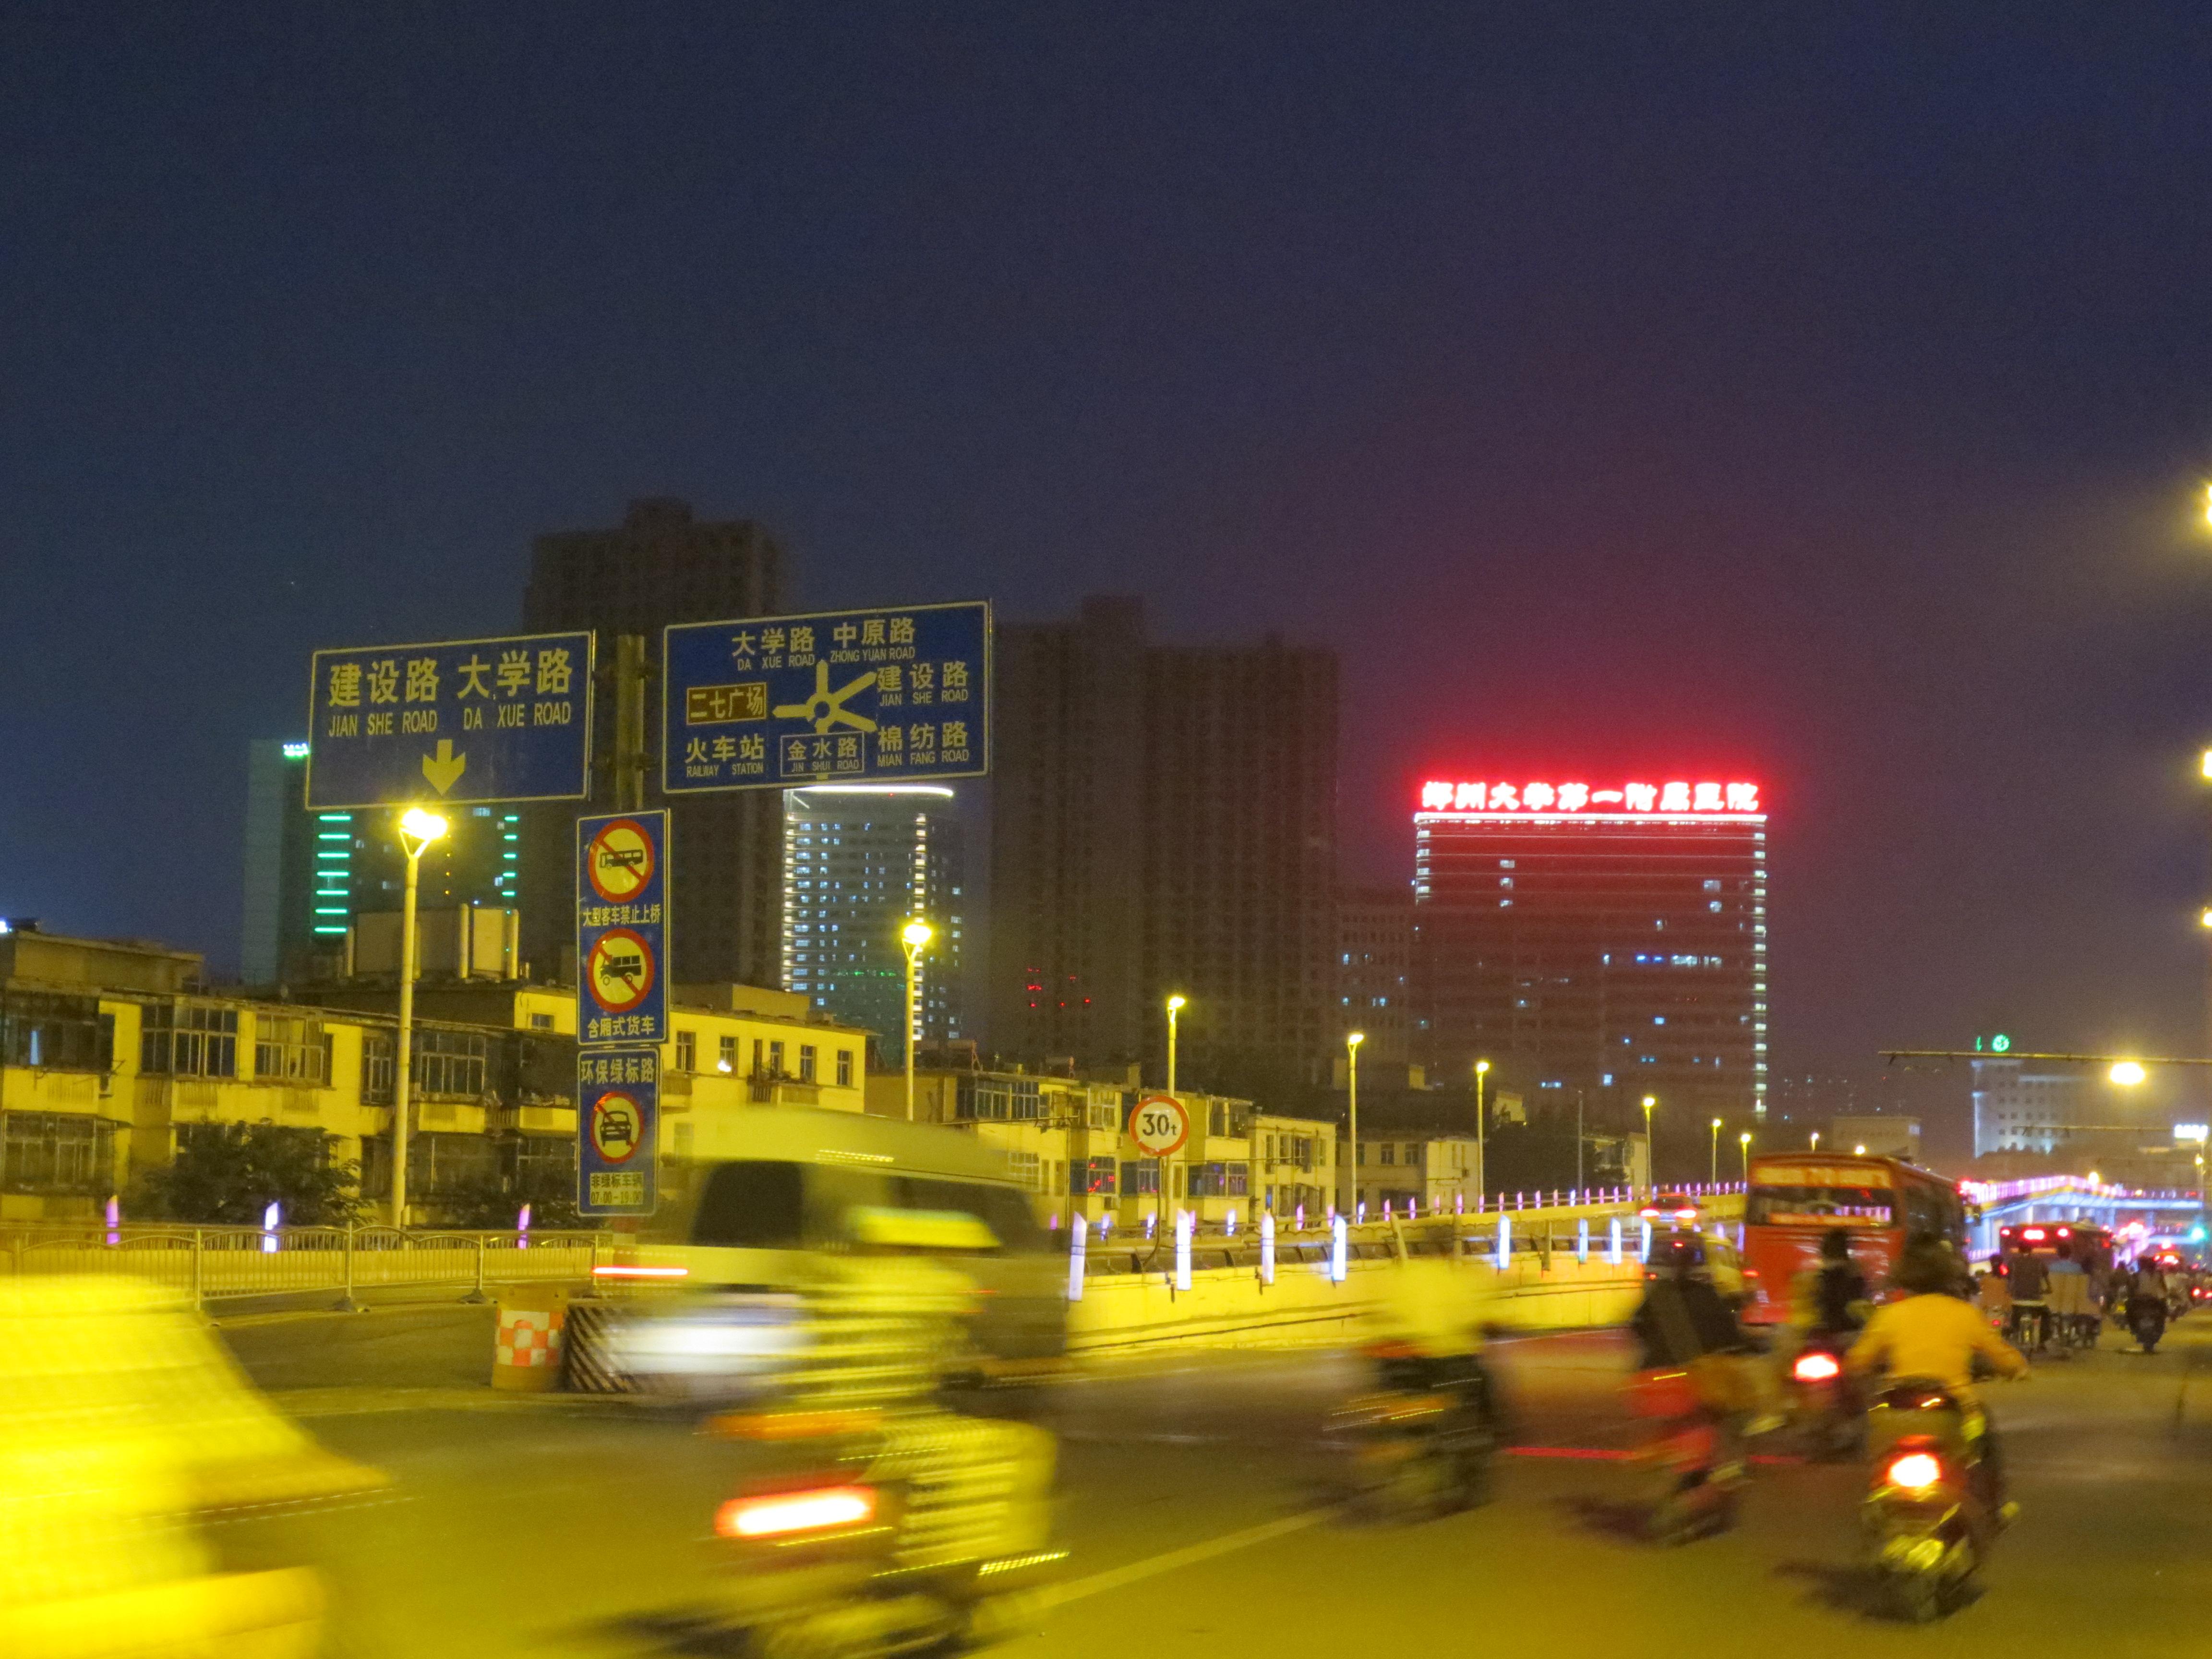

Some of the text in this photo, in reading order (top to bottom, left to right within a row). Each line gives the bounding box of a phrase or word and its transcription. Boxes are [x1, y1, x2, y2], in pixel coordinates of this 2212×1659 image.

[732, 617, 916, 658] 大学路 中原路
[738, 645, 916, 671] DA XUE ROAD ZHONG YUAN ROAD
[329, 648, 573, 707] 建设路 大学路
[877, 661, 969, 693] 建设路
[689, 685, 764, 719] 二七广场
[879, 689, 968, 707] JIAN SHE ROAD
[329, 701, 571, 737] JIAN SHE ROAD DA XUE ROAD
[685, 733, 765, 763] 火车站
[788, 737, 857, 760] 金水路
[878, 721, 968, 753] 棉纺路
[686, 762, 764, 777] RAILWAY STATION
[793, 759, 859, 772] JIN SHUI ROAD
[878, 749, 969, 767] MIAN FANG ROAD
[583, 903, 661, 927] 大型客车禁止上桥
[588, 1015, 655, 1038] 含厢式货车
[581, 1058, 654, 1085] 环保绿标路
